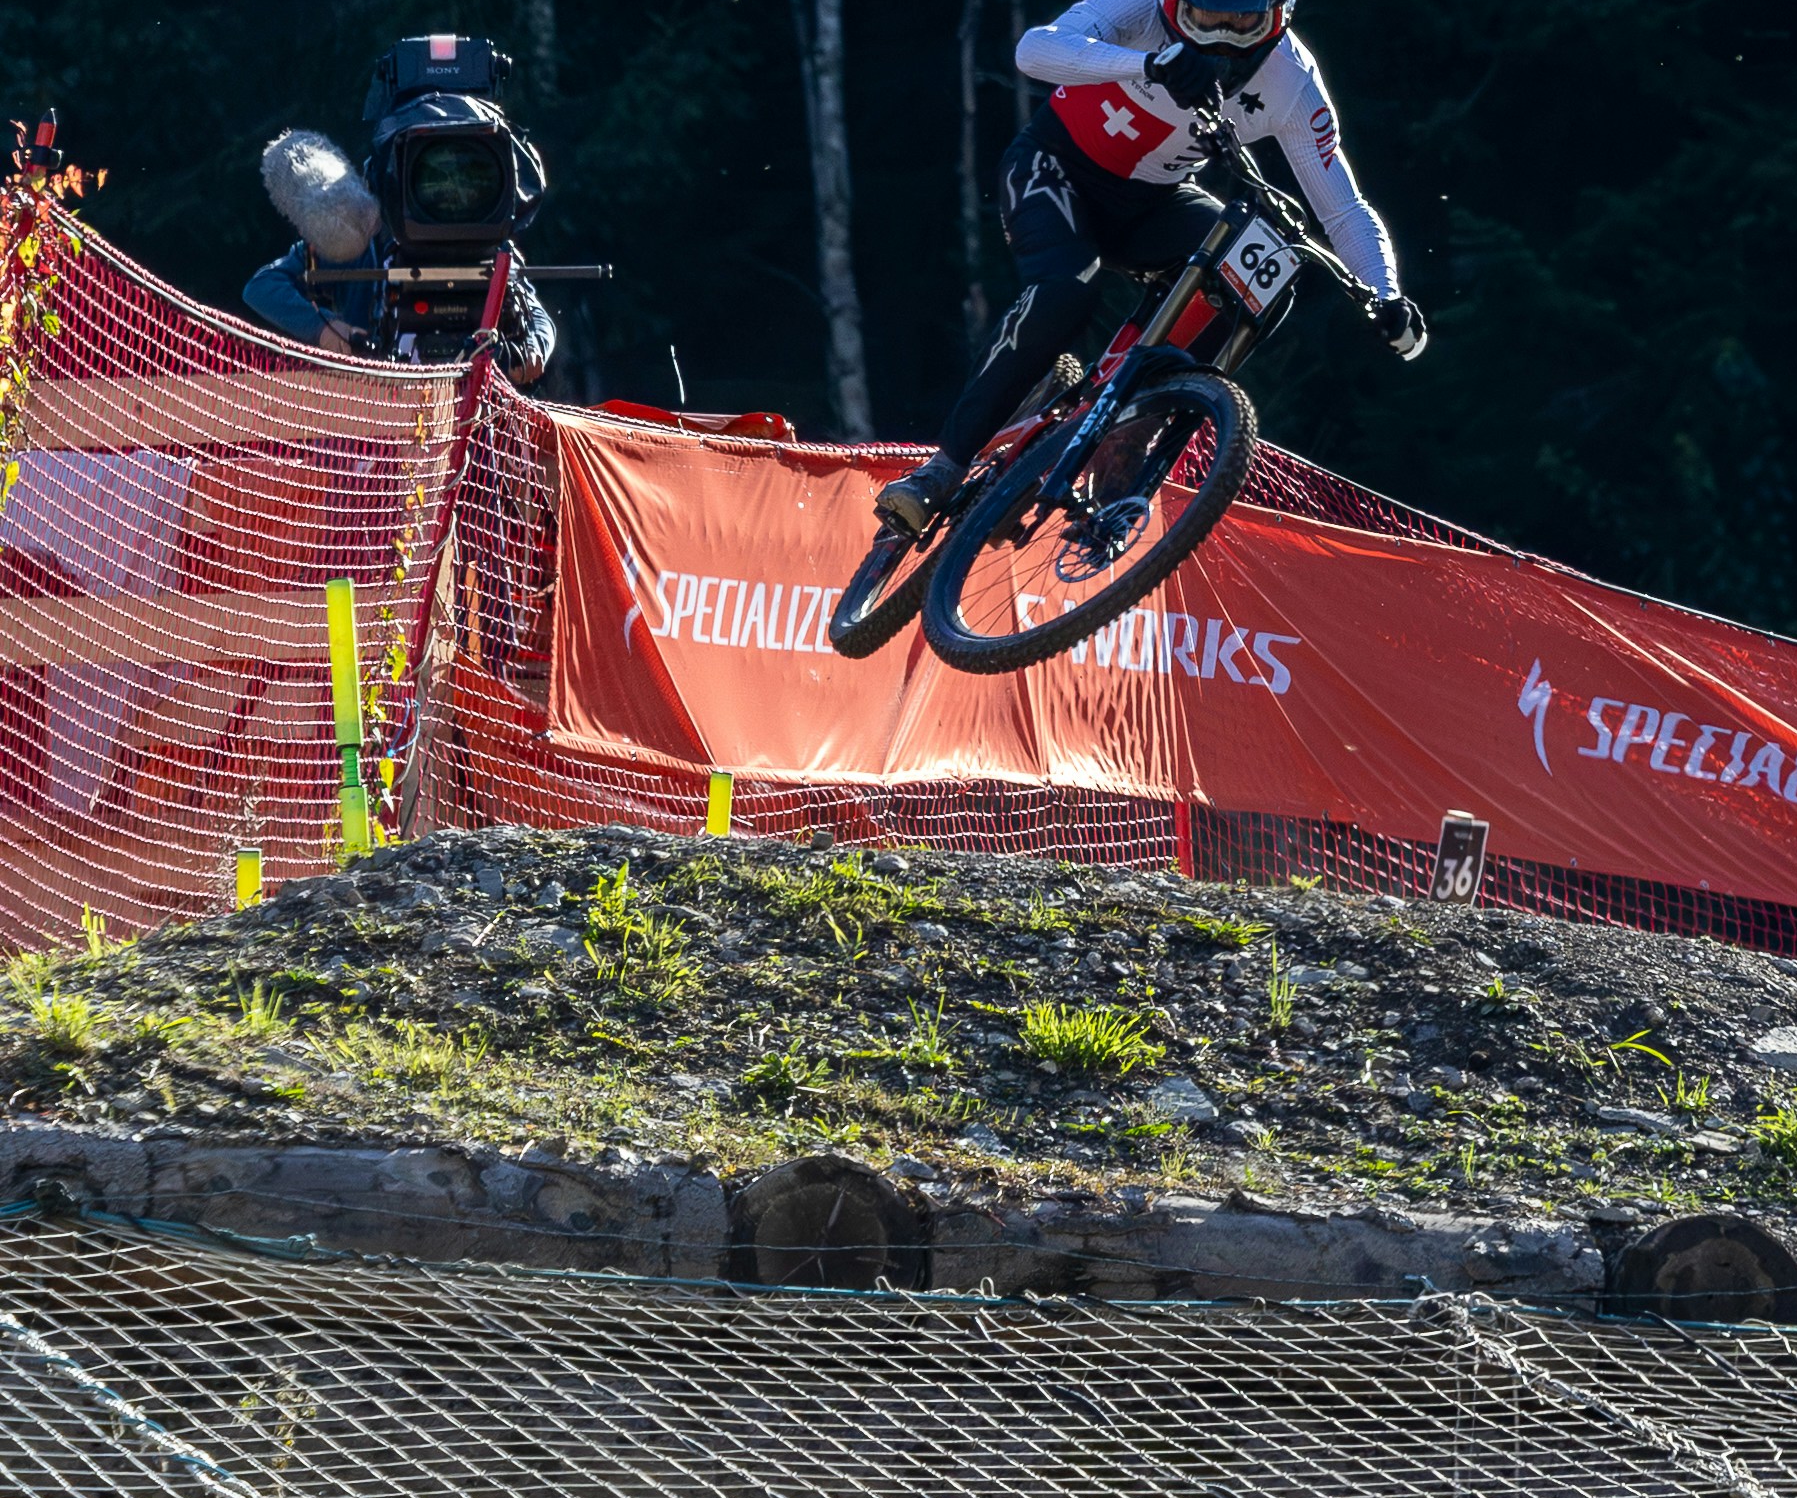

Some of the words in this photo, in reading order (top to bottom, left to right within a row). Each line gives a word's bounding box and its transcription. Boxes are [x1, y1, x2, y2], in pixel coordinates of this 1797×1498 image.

[425, 66, 460, 75] SONY
[1239, 242, 1281, 290] 68
[650, 569, 844, 654] SPECIALIZE
[1016, 591, 1303, 695] SWORKS
[1436, 855, 1474, 901] 36
